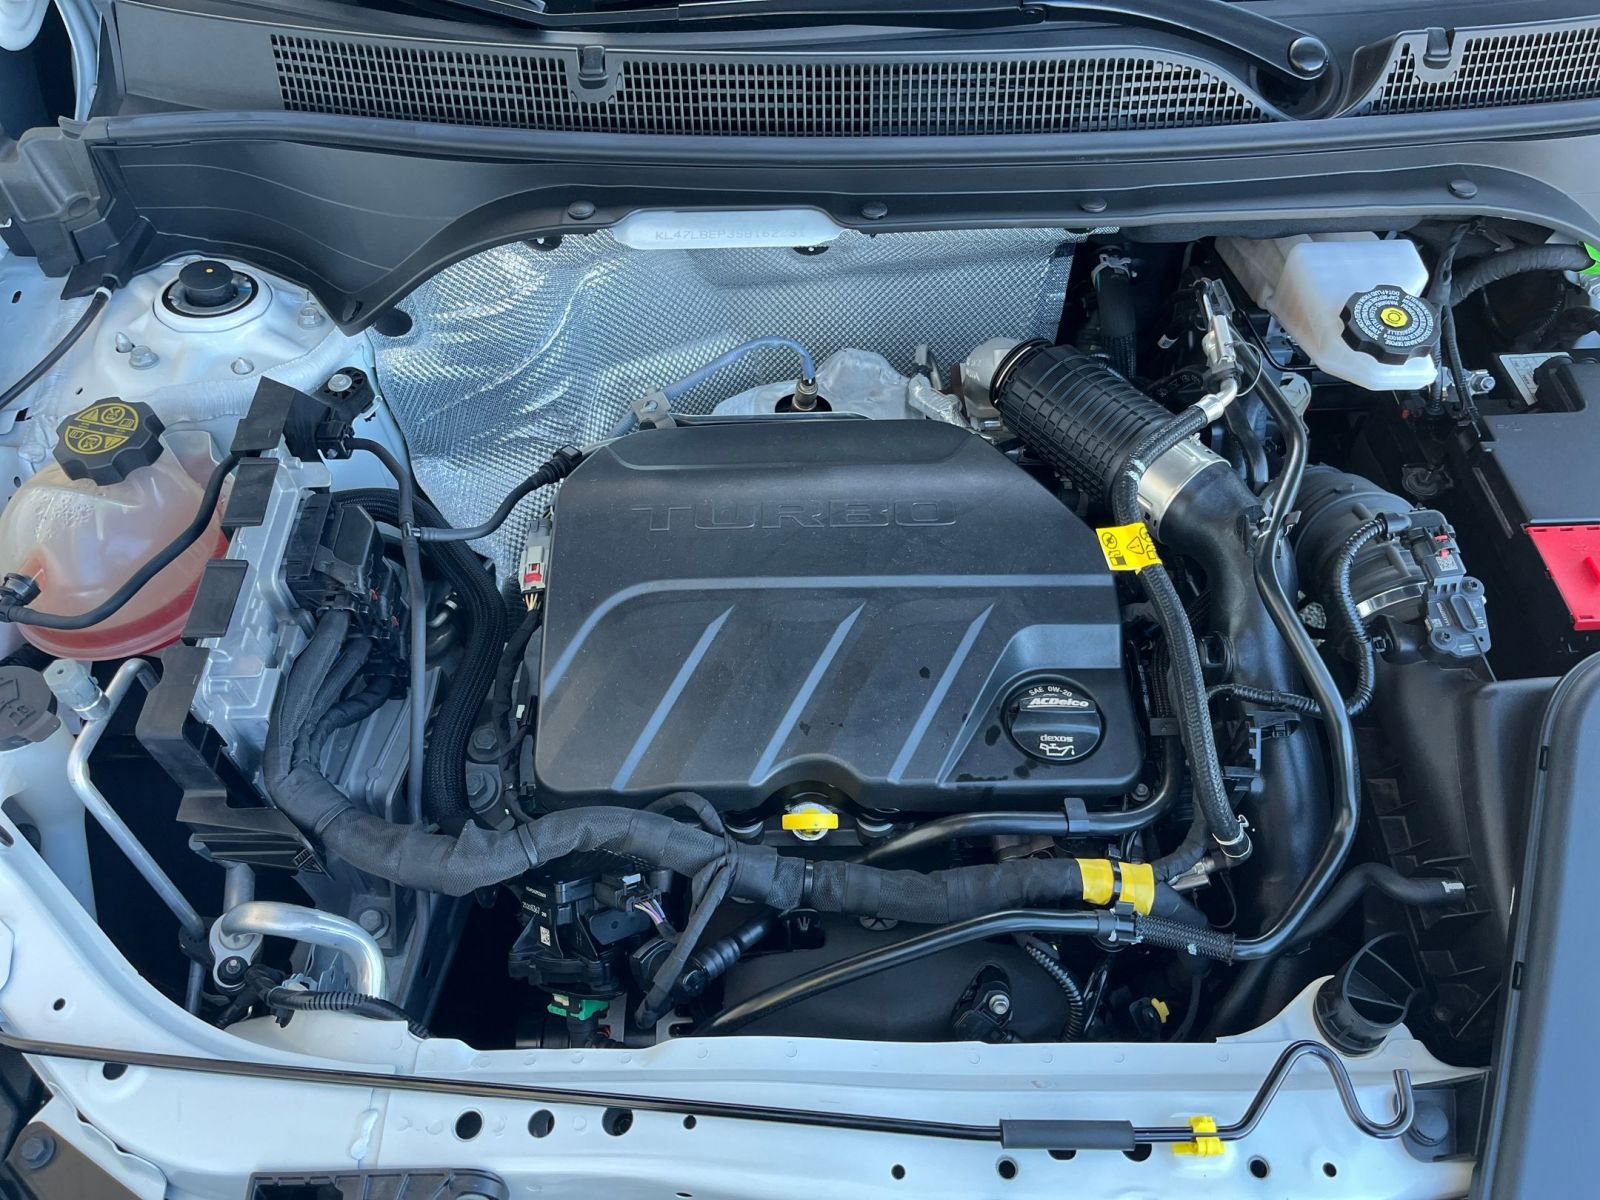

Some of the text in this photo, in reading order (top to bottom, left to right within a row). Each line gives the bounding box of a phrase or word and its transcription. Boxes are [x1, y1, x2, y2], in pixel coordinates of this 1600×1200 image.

[630, 500, 958, 531] TURBO
[1029, 686, 1073, 697] SAE 0W-20
[1030, 697, 1089, 708] ACDelco
[1040, 734, 1074, 743] dexos
